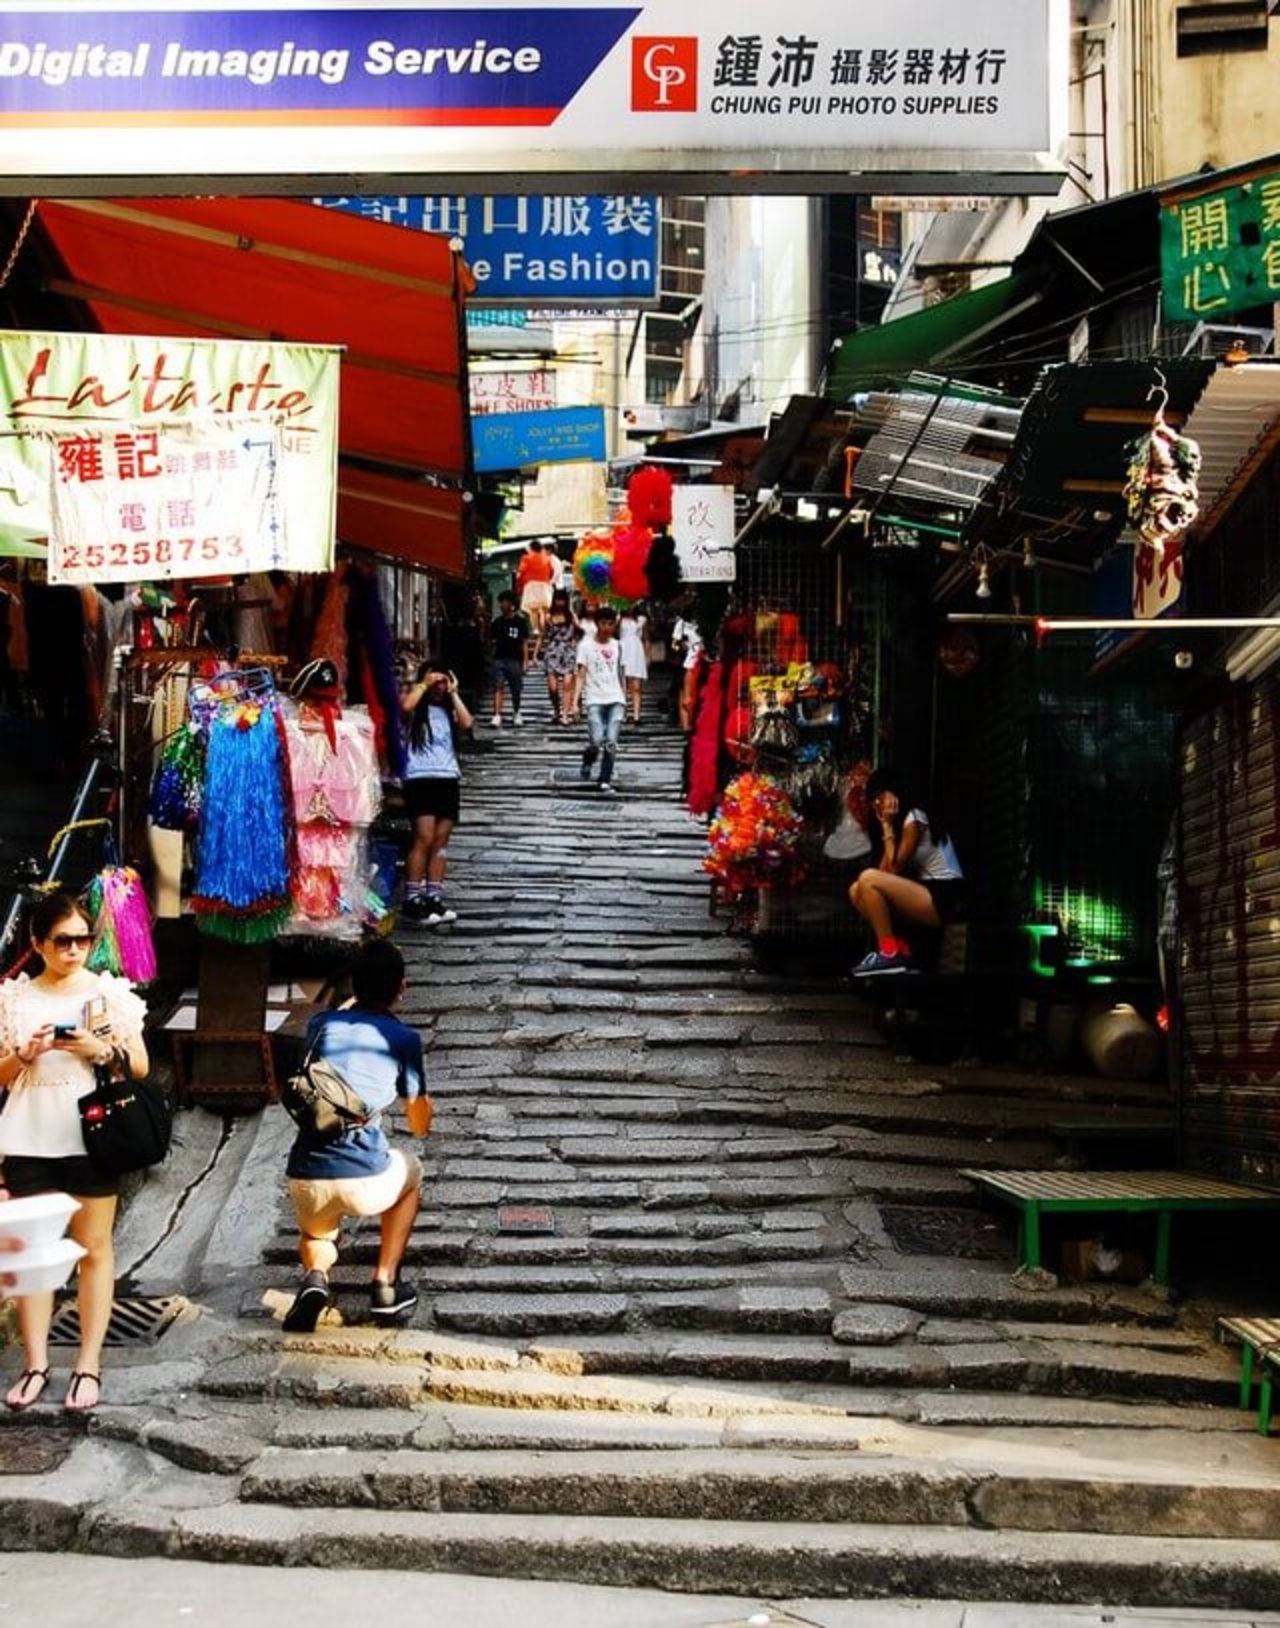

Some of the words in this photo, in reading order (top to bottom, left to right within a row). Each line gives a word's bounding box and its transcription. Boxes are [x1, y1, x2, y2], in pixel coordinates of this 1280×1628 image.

[0, 41, 149, 84] Digital
[161, 43, 349, 84] Imaging
[363, 41, 541, 75] Service
[713, 35, 819, 87] 鍾沛
[829, 48, 1007, 84] 攝影器材行
[710, 95, 781, 115] CHUNG
[787, 96, 820, 114] PUI
[827, 95, 897, 115] PHOTO
[902, 95, 998, 115] SUPPLIES
[503, 253, 651, 281] Fashion
[1181, 199, 1231, 311] 開心
[119, 500, 196, 532] 電話
[62, 536, 244, 569] 25258753
